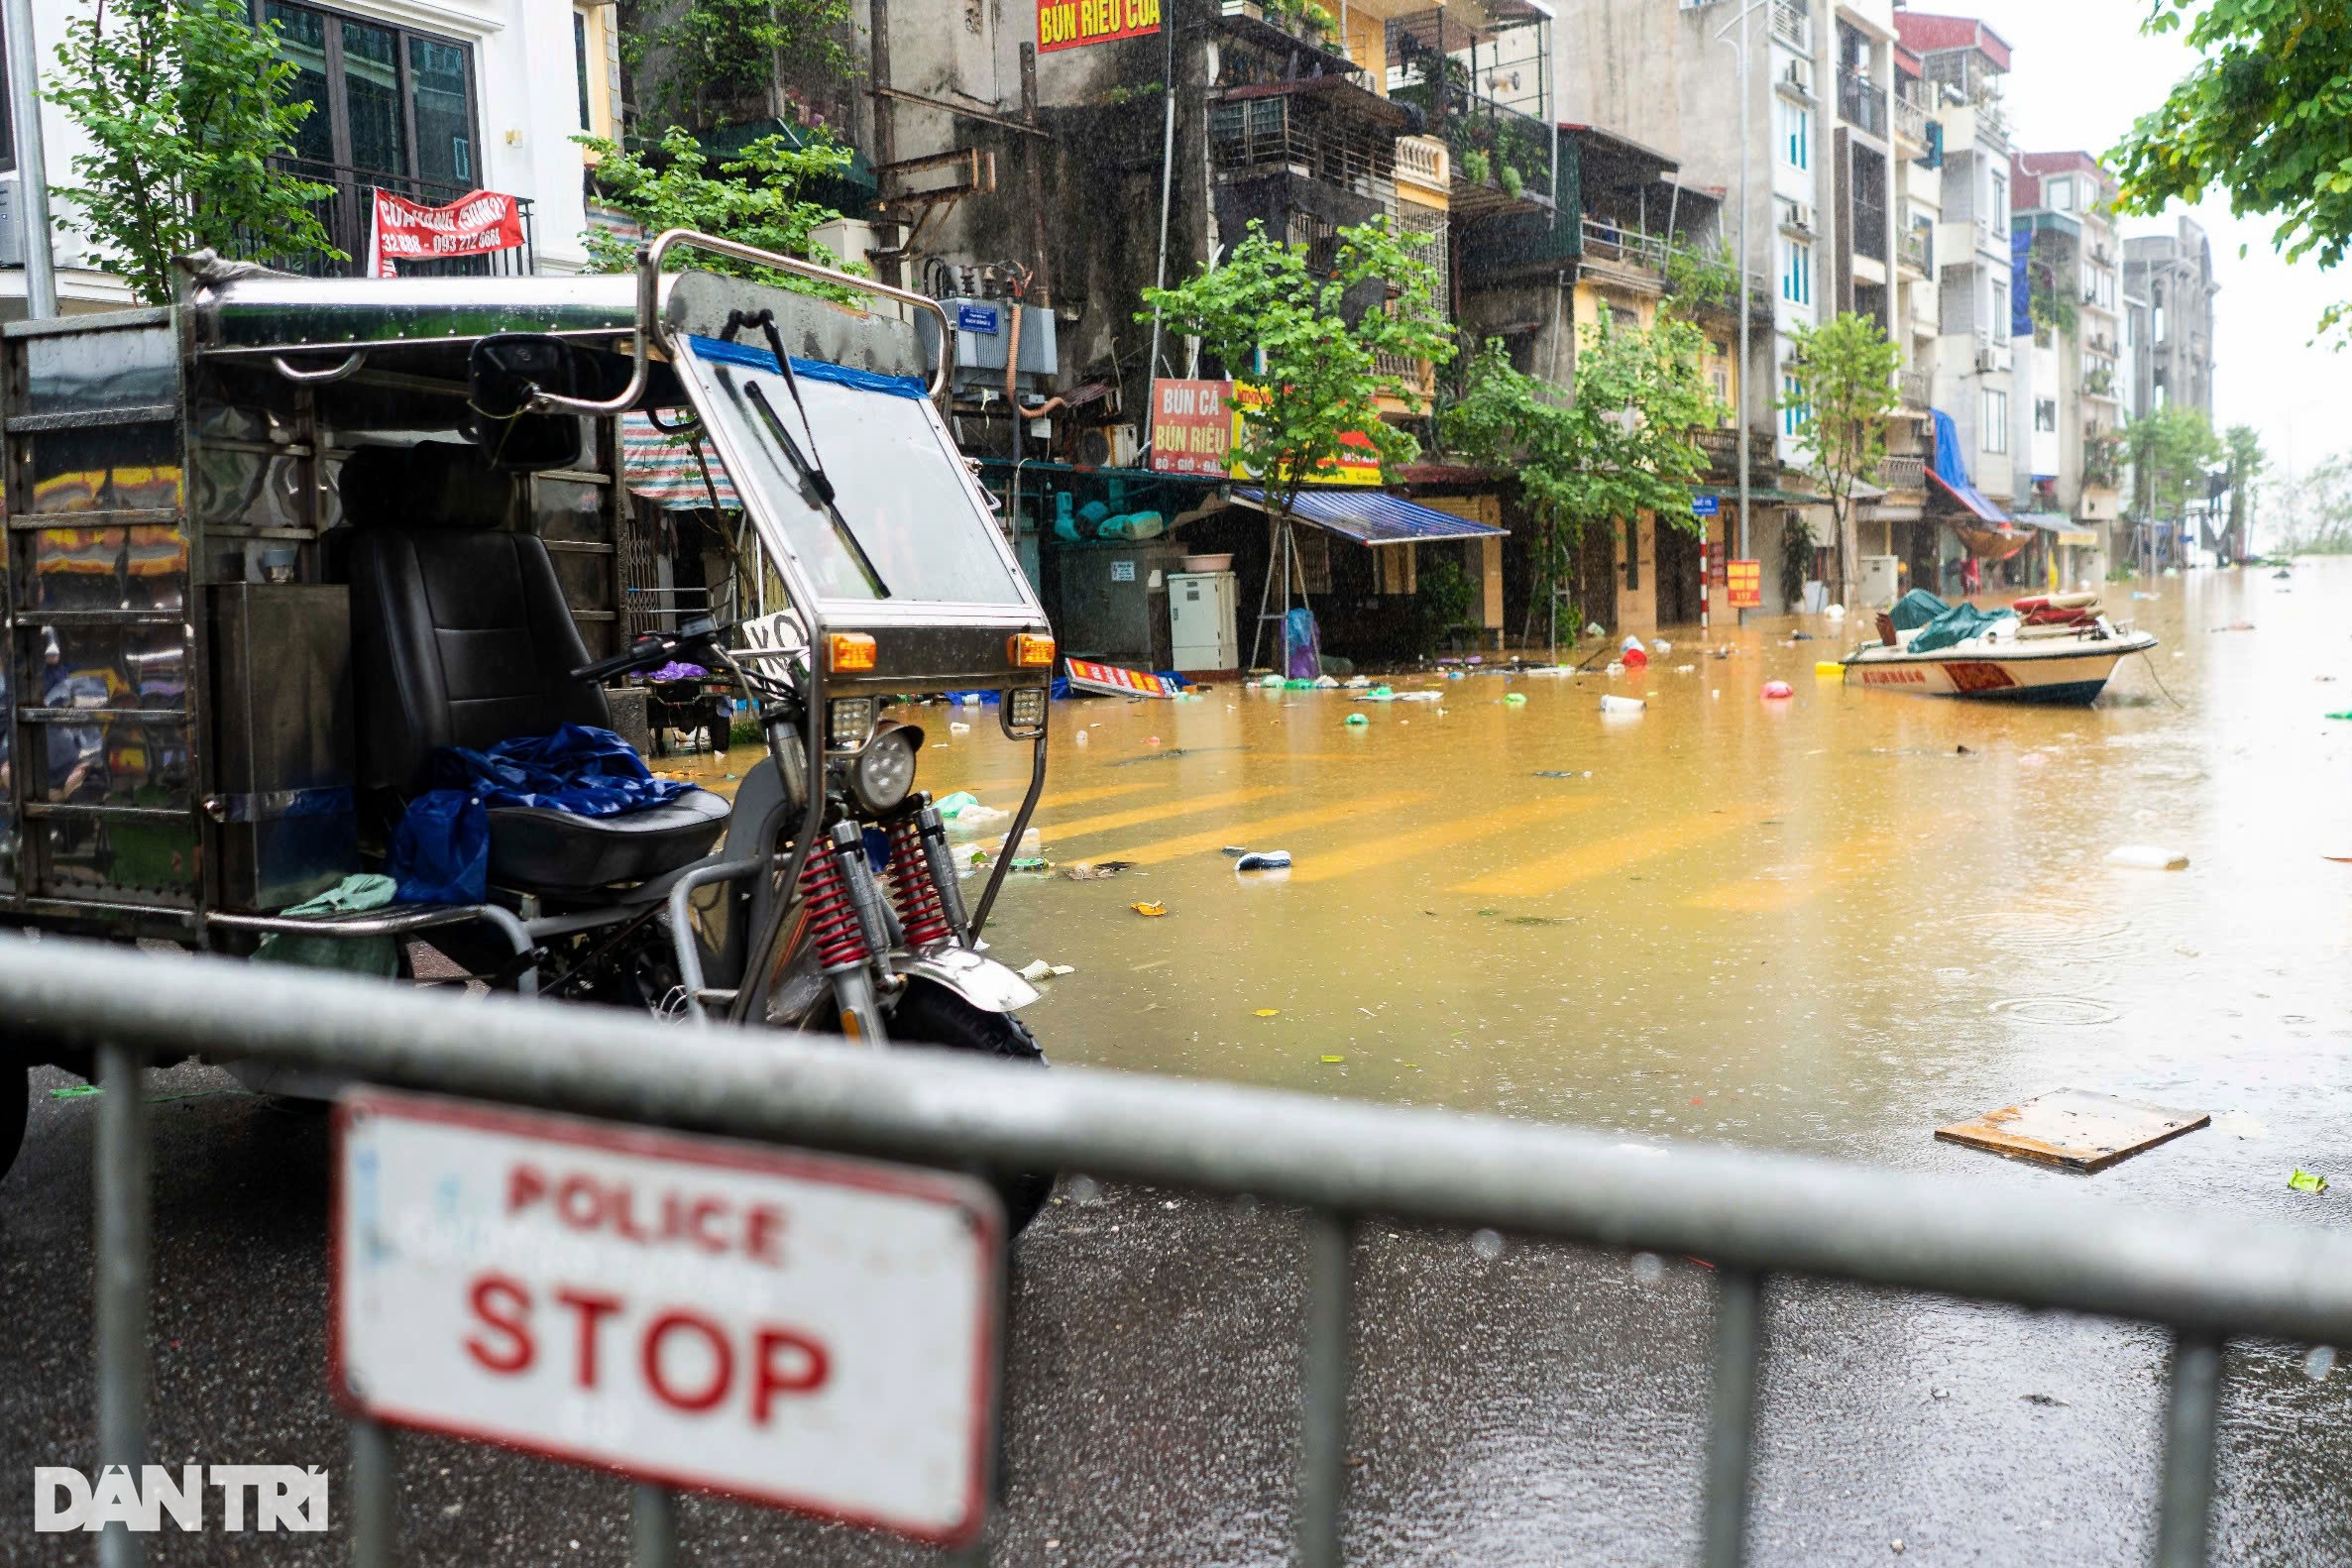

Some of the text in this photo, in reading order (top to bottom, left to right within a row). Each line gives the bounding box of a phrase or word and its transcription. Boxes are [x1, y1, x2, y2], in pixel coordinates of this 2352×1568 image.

[1164, 383, 1194, 415] BÚN
[1198, 384, 1220, 416] CÁ
[1155, 419, 1226, 455] BÚN RIÊU
[505, 1162, 787, 1267] POLICE
[464, 1270, 832, 1429] STOP
